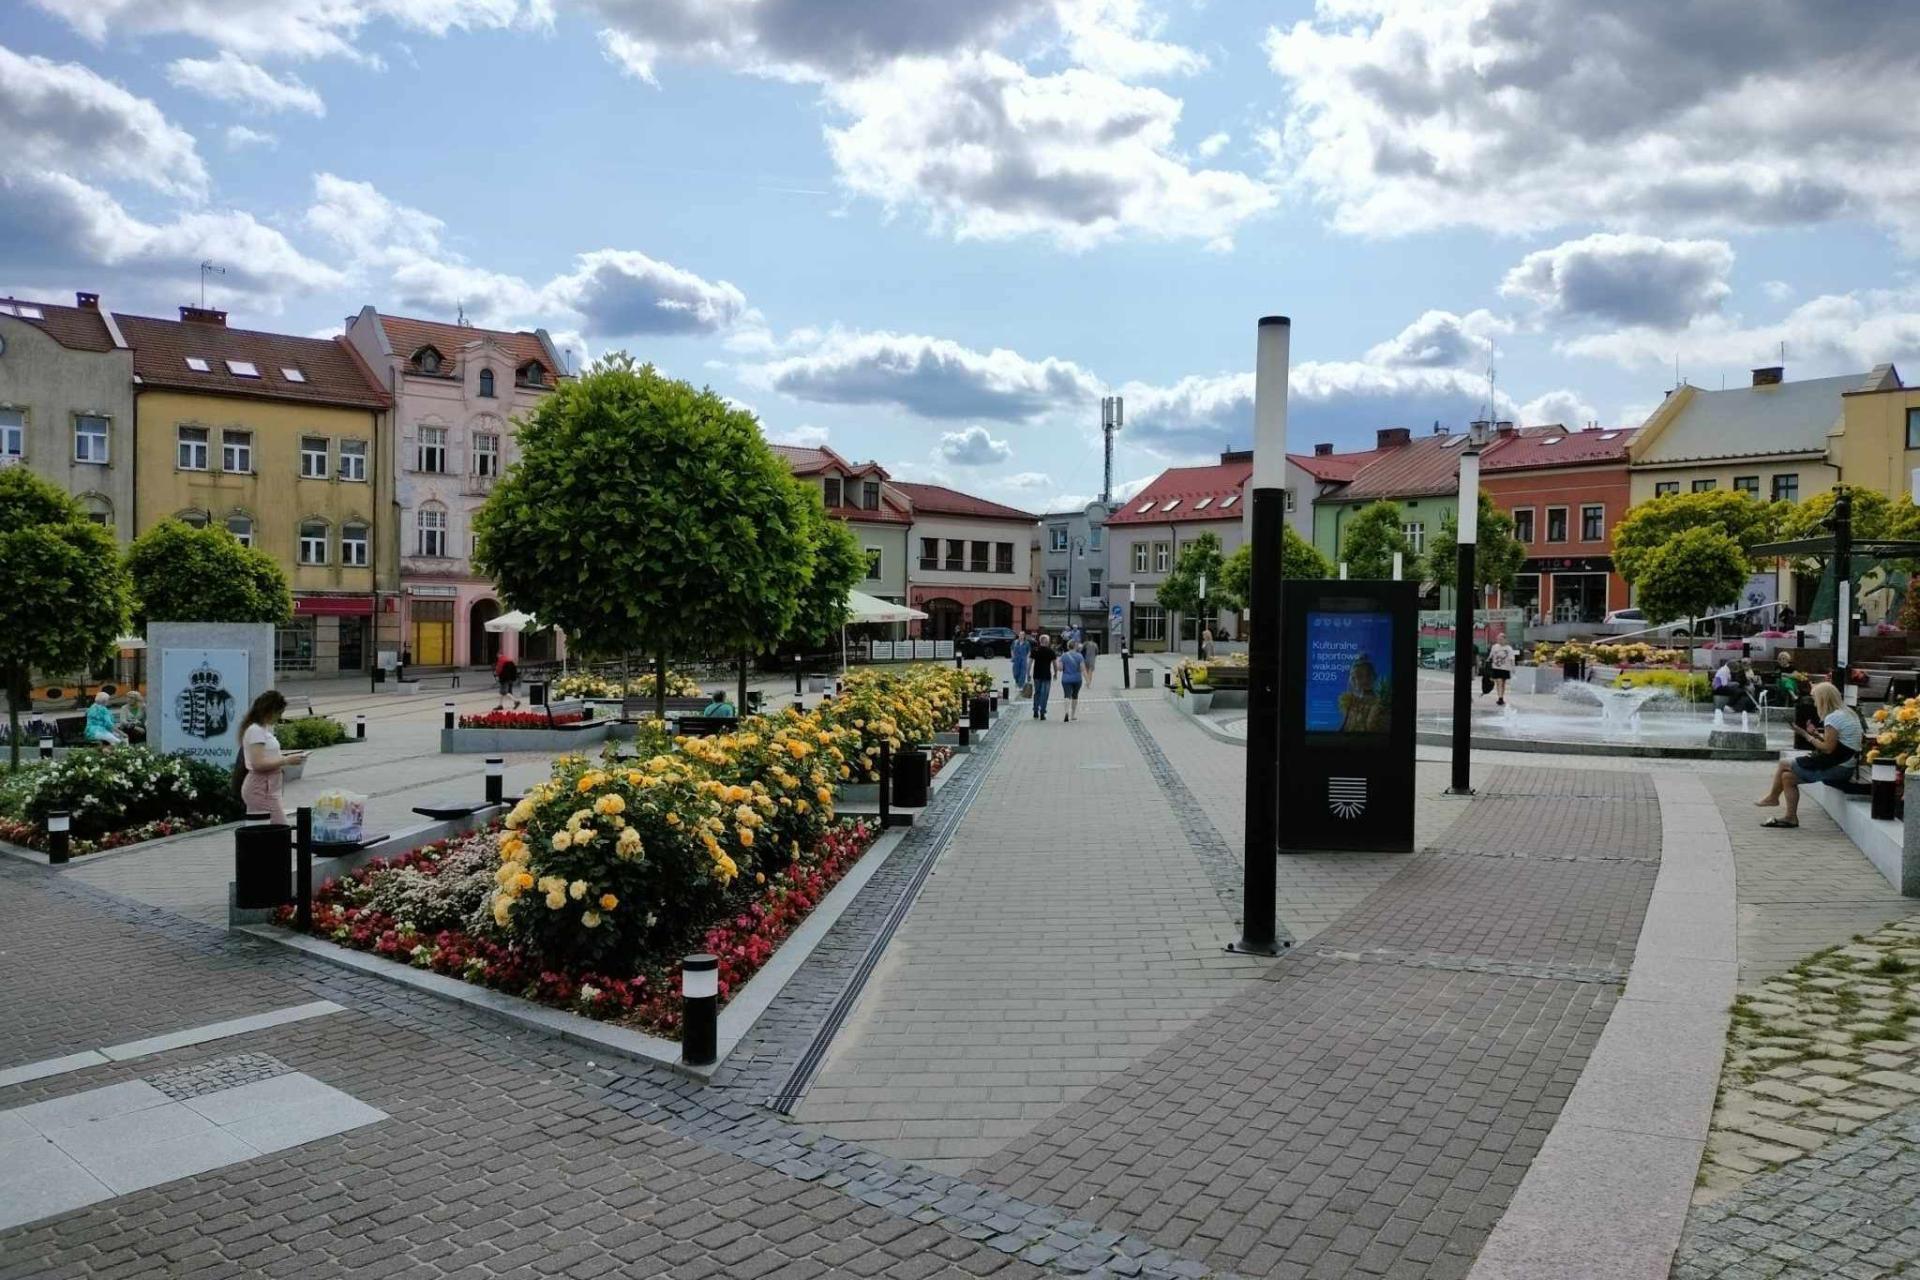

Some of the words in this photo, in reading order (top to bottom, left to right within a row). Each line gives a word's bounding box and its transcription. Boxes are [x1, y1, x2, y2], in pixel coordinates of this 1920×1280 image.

[1312, 641, 1358, 650] Kulturalne
[1317, 652, 1360, 662] sportowe
[1312, 663, 1351, 673] wakacje
[1312, 672, 1337, 681] 2025
